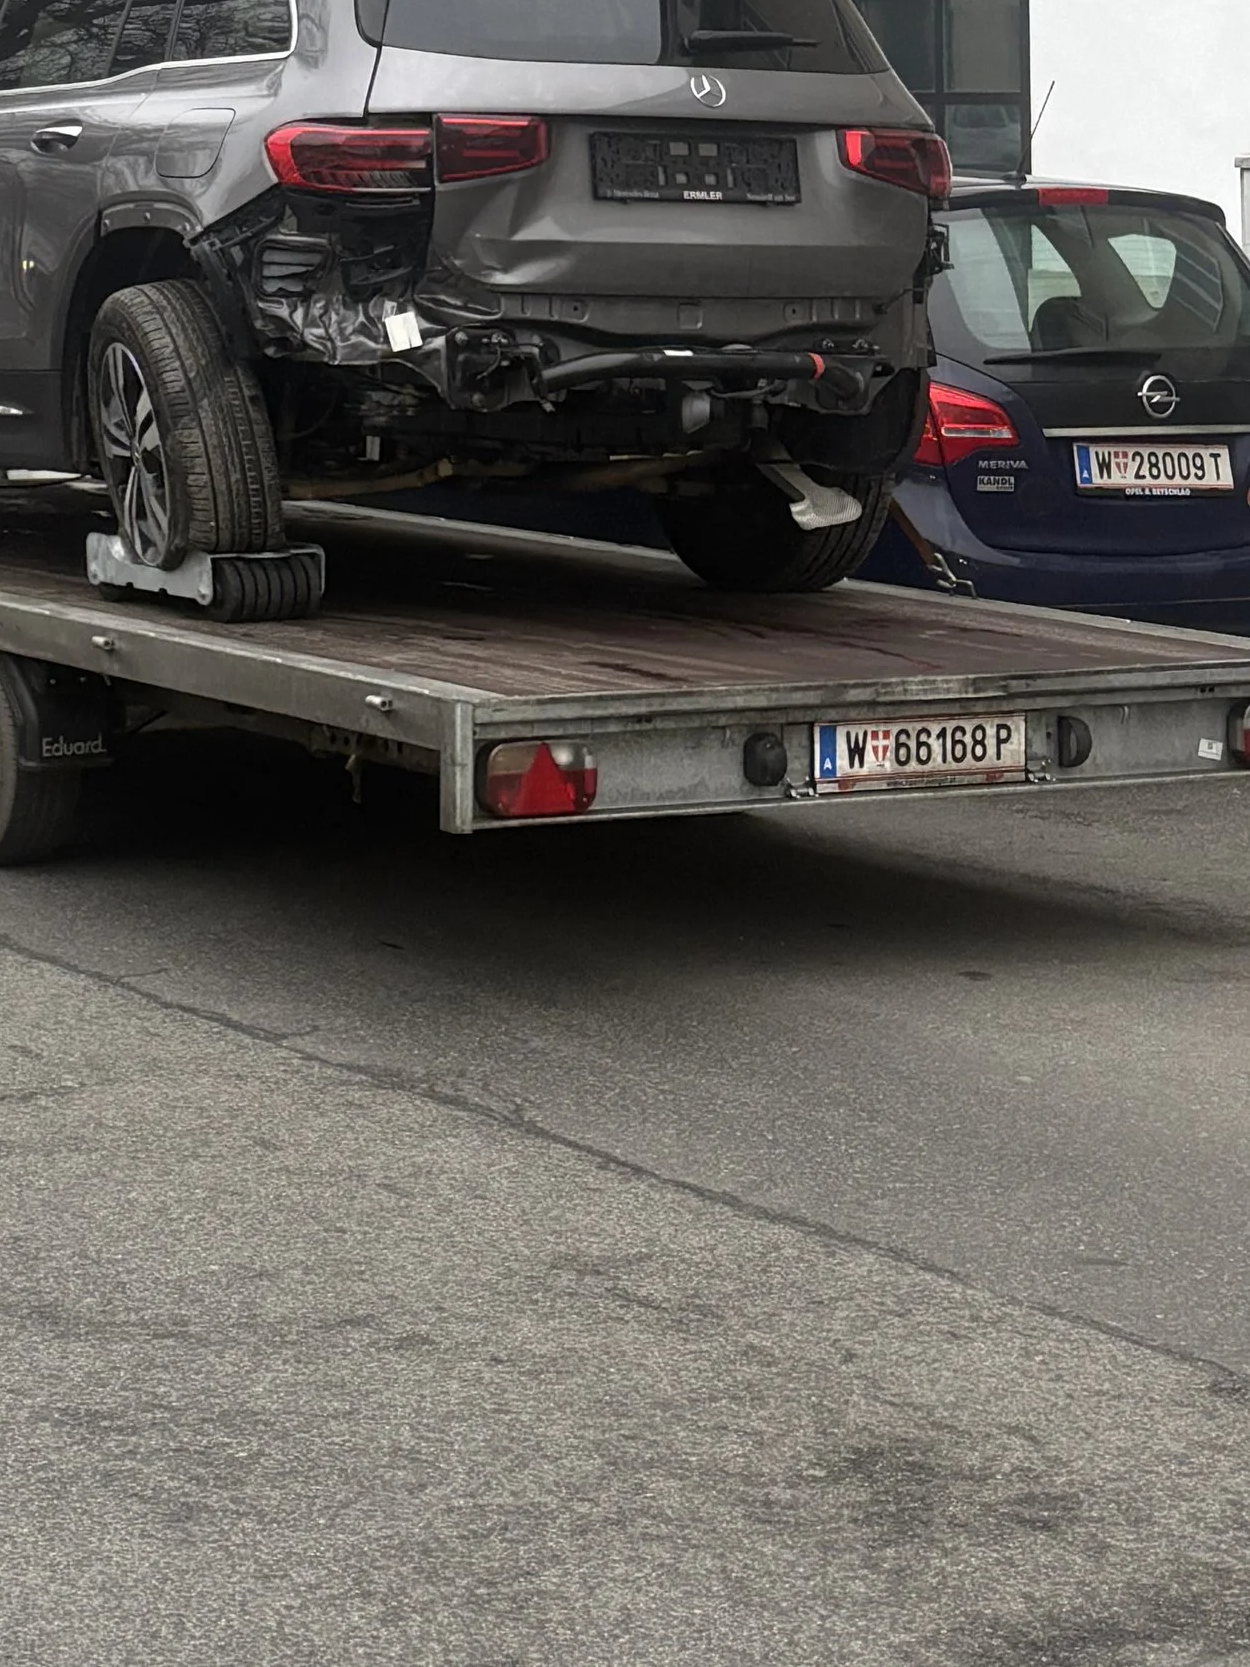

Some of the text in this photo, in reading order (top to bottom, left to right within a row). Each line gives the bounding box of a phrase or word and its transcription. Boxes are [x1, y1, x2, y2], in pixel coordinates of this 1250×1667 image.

[682, 190, 723, 201] ERMLER
[978, 459, 1029, 470] MERIVA
[1081, 450, 1222, 481] A W 28009 T
[978, 476, 1013, 486] KANDL
[42, 734, 107, 758] Eduard
[823, 722, 1012, 771] A W 66168 P
